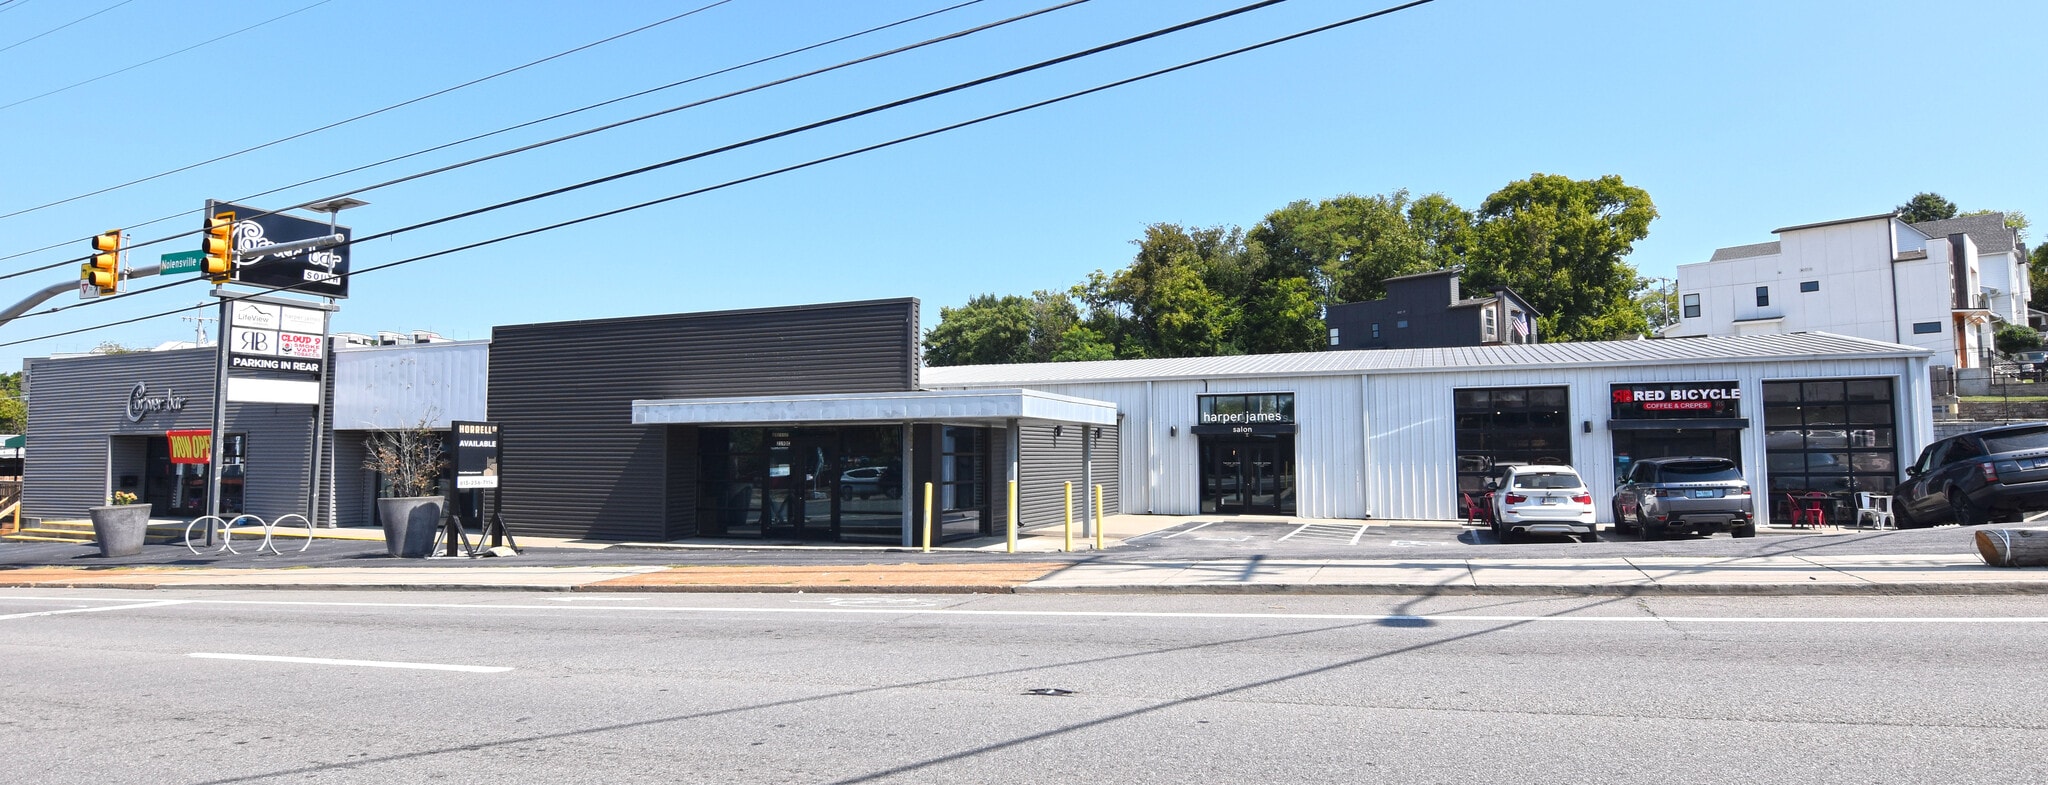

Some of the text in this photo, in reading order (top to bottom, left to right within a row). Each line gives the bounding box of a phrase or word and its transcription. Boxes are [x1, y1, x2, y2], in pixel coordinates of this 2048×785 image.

[161, 257, 197, 270] Nolensville
[238, 314, 269, 323] LifeView
[281, 334, 321, 345] CLOUD 9
[233, 357, 319, 372] PARKING IN REAR
[1633, 390, 1666, 401] RED
[1670, 388, 1741, 400] BICYCLE
[127, 381, 165, 422] Corner
[1203, 411, 1282, 425] harper james
[459, 425, 492, 434] HORRELL
[170, 435, 212, 459] NOW OPE
[459, 440, 497, 448] AVAILABLE
